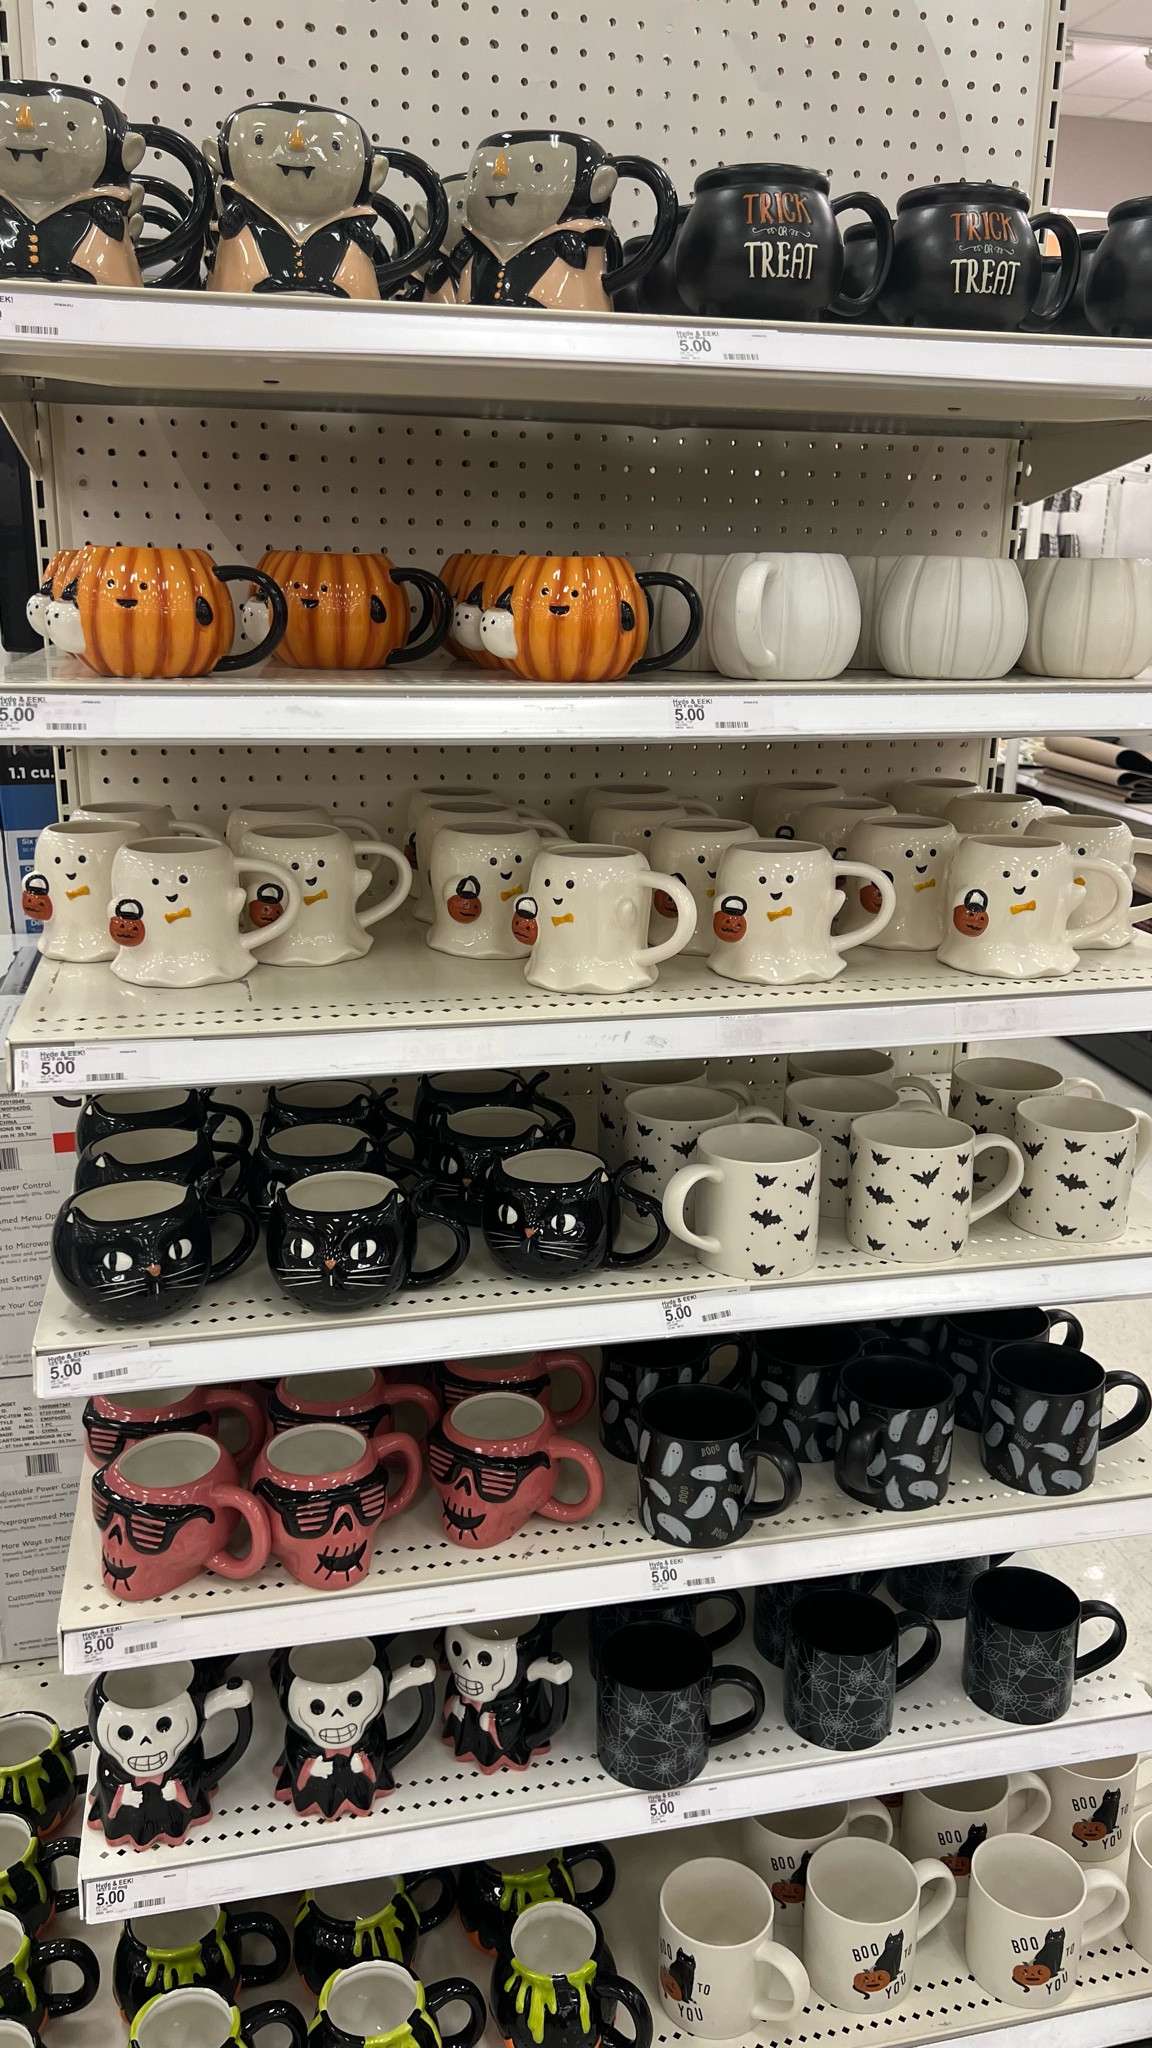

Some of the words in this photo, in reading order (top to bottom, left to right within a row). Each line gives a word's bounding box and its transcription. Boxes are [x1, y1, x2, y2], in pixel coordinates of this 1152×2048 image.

[743, 192, 813, 225] TRICK
[778, 227, 788, 236] OR
[950, 211, 1019, 244] TRICK
[983, 244, 994, 254] OR
[743, 241, 818, 280] TREAT
[950, 258, 1021, 296] TREAT
[680, 340, 712, 352] 5.00
[0, 708, 34, 721] 5.00
[675, 709, 705, 720] 5.00
[8, 767, 26, 779] 1.1
[31, 768, 54, 779] cu.
[41, 1061, 75, 1075] 5.00
[23, 1181, 51, 1190] Control
[45, 1213, 57, 1221] Op
[12, 1274, 42, 1283] Settings
[665, 1305, 691, 1321] 5.00
[50, 1362, 82, 1380] 5.00
[701, 1444, 720, 1458] BOOO
[36, 1485, 58, 1493] Power
[22, 1567, 48, 1576] Defrost
[652, 1568, 677, 1583] 5.00
[8, 1592, 45, 1602] Customize
[84, 1637, 114, 1654] 5.00
[650, 1801, 674, 1816] 5.00
[1072, 1796, 1097, 1811] BOO
[1121, 1804, 1129, 1815] TO
[938, 1830, 962, 1845] BOO
[1102, 1831, 1122, 1850] YOU
[771, 1856, 796, 1872] BOO
[97, 1890, 124, 1905] 5.00
[852, 1943, 879, 1963] BOO
[904, 1943, 912, 1959] TO
[1011, 1937, 1039, 1954] BOO
[1066, 1943, 1075, 1957] TO
[697, 1983, 711, 1995] TO
[885, 1975, 907, 1999] YOU
[1045, 1973, 1069, 1995] YOU
[678, 2003, 703, 2022] YOU
